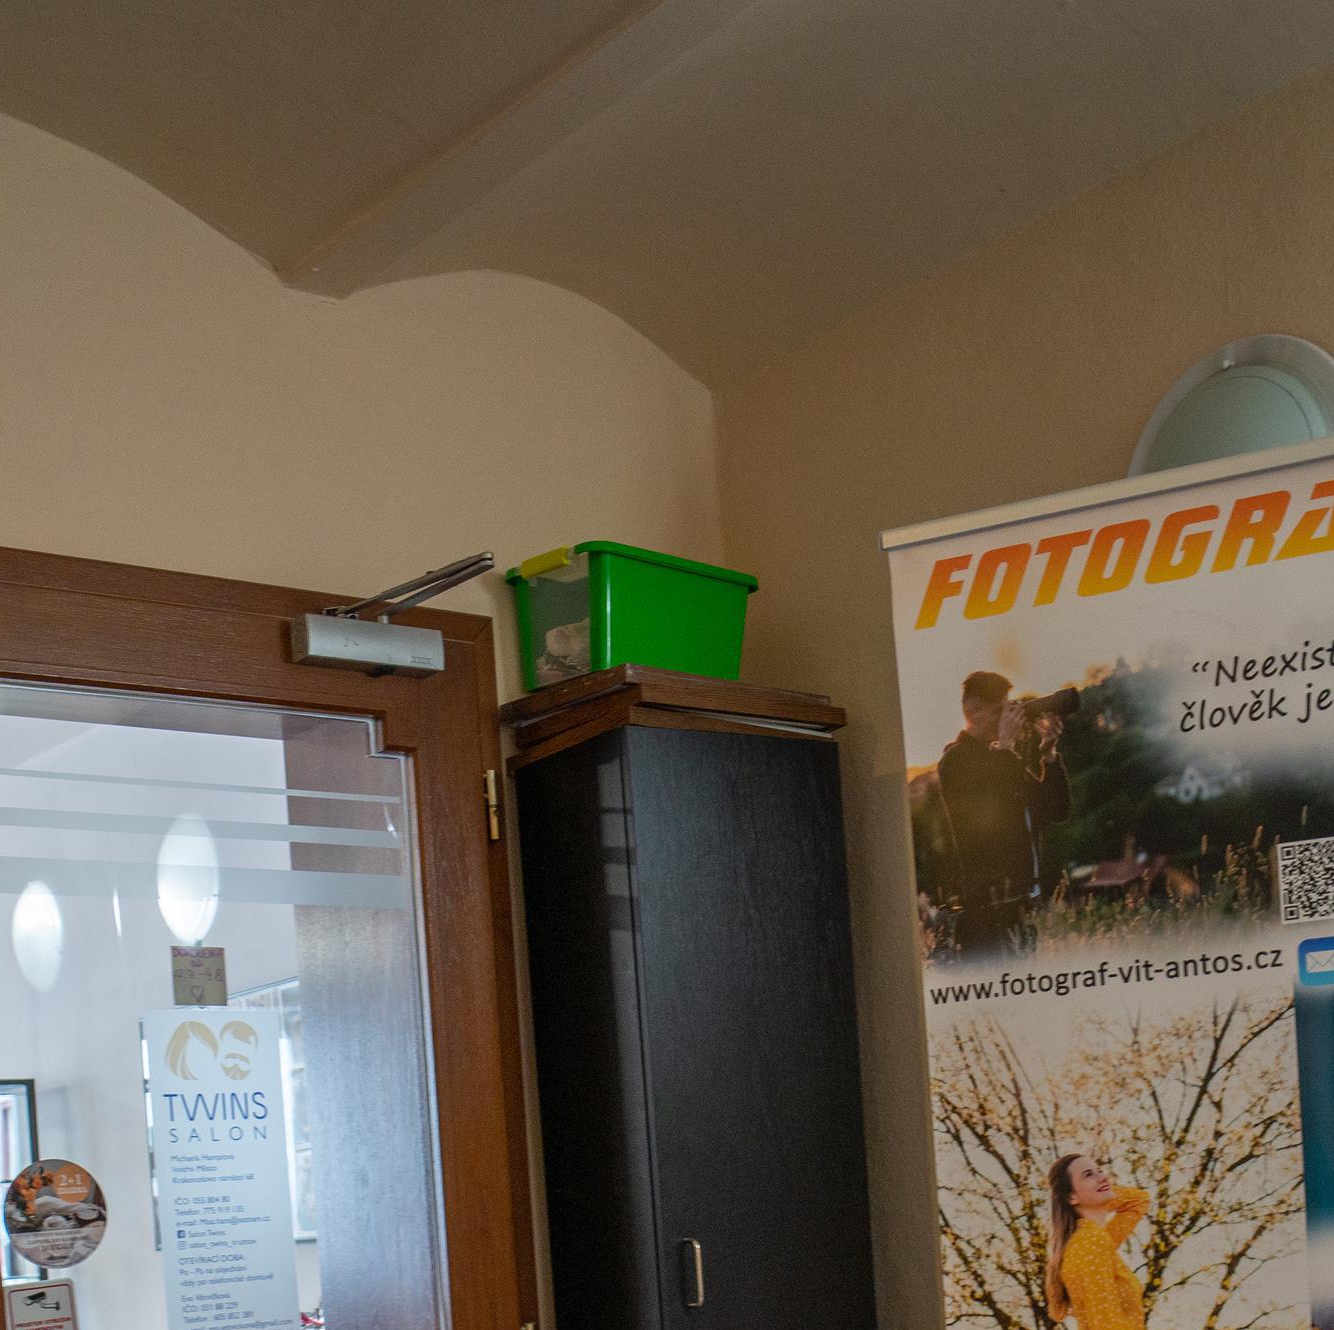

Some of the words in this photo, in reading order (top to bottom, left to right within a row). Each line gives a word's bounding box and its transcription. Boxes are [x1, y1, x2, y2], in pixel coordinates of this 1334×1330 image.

[1179, 687, 1289, 734] člověk
[930, 947, 1285, 1006] www.fotograf-vit-antos.cz
[163, 1091, 268, 1121] TWINS
[169, 1126, 267, 1143] SALON
